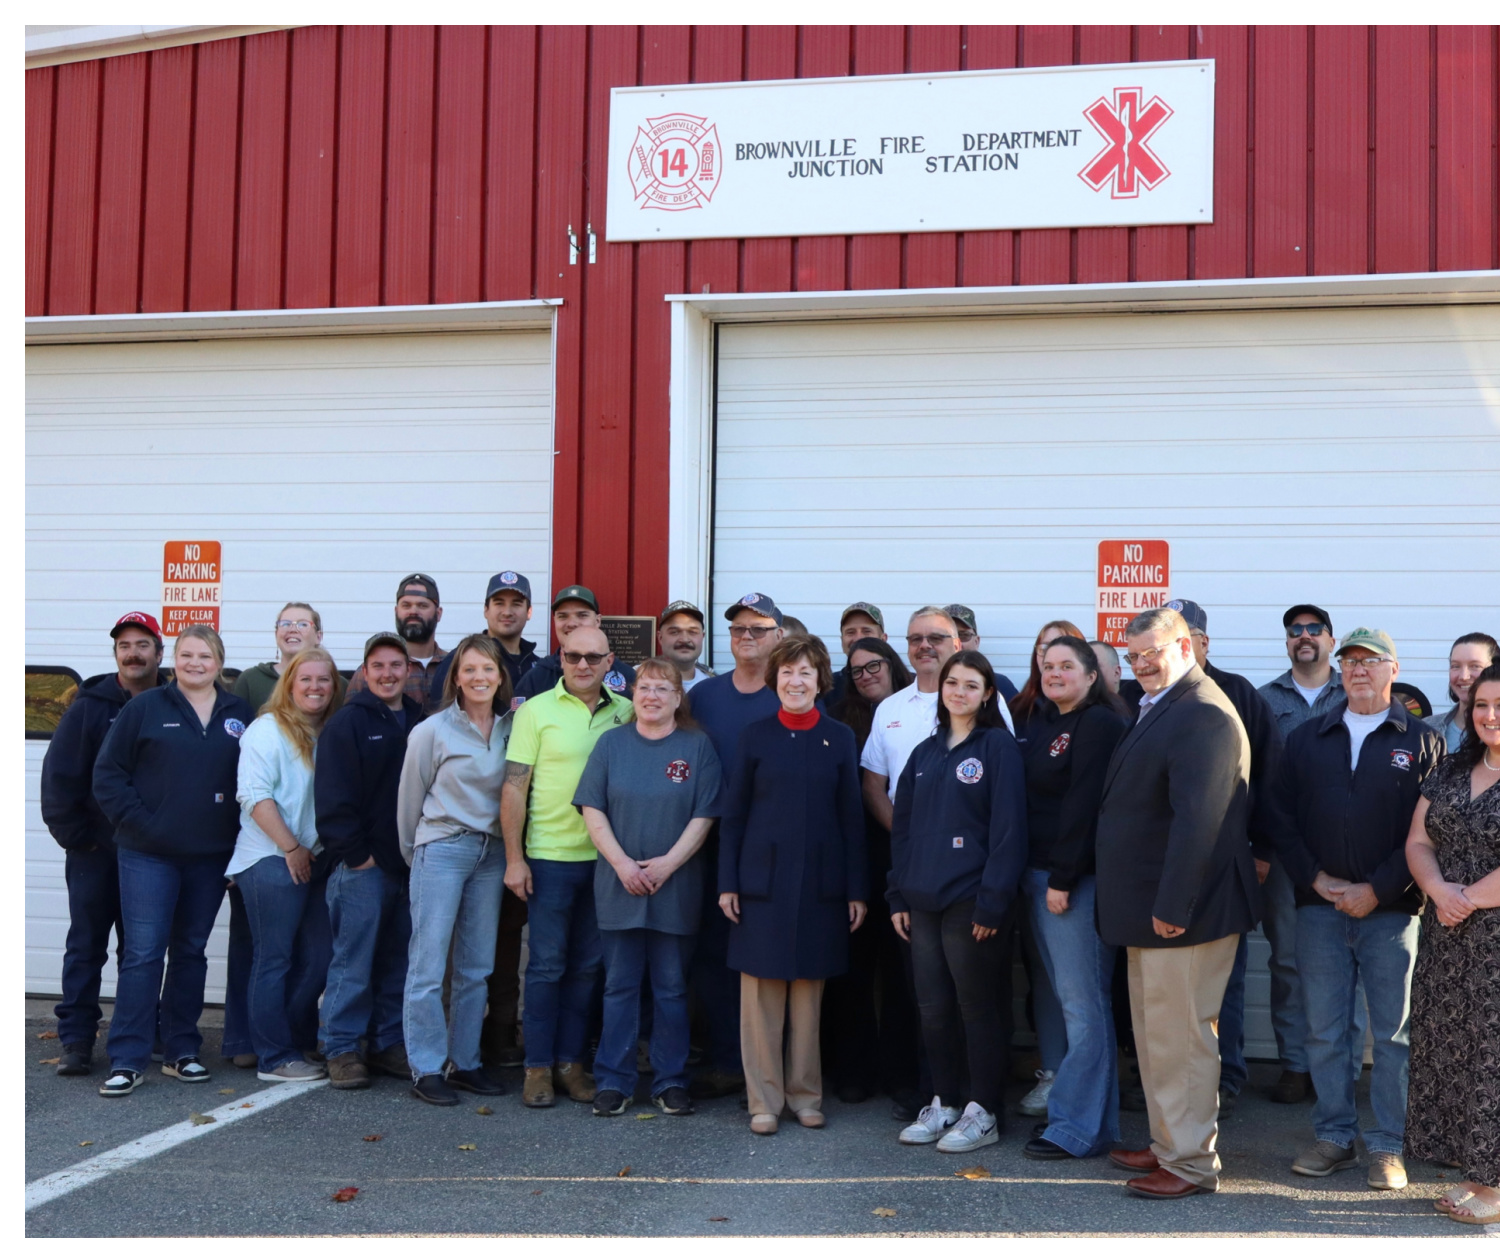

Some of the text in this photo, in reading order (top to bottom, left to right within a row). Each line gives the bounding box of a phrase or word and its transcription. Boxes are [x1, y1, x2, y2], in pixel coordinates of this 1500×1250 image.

[653, 121, 699, 136] BROWNVILLE
[735, 129, 1082, 161] BROWNVILLE FIRE DEPARTMENT
[658, 149, 688, 178] 14
[788, 153, 1019, 178] JUNCTION STATION
[650, 190, 695, 202] FIRE DEPT.
[184, 544, 200, 561] NO
[1124, 544, 1143, 563] NO
[167, 563, 217, 580] PARKING
[1103, 565, 1163, 584] PARKING
[164, 587, 219, 602] FIRE LANE
[1099, 592, 1127, 608] FIRE
[1133, 592, 1166, 608] LANE
[169, 610, 213, 620] KEEP CLEAR
[1106, 617, 1128, 628] KEEP
[166, 622, 175, 632] AT
[1103, 631, 1128, 643] AT AL
